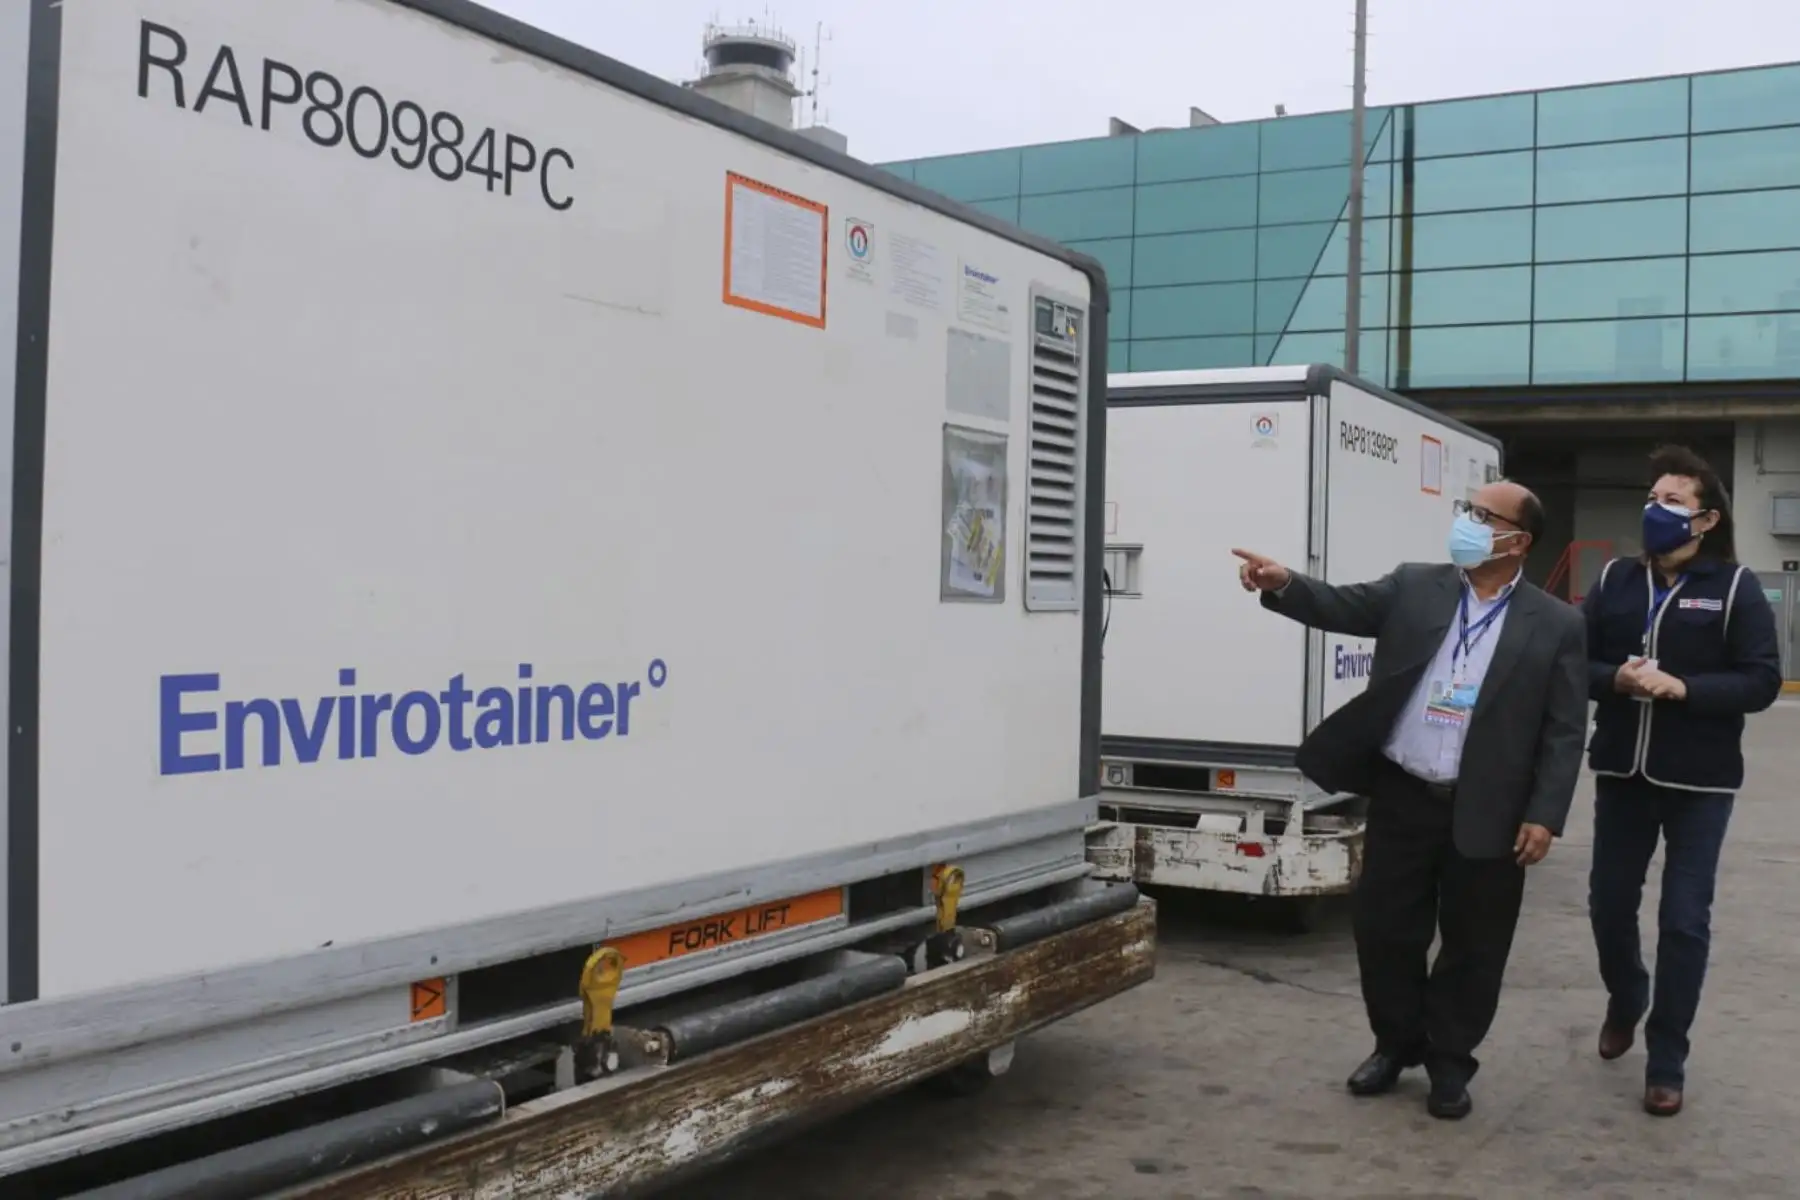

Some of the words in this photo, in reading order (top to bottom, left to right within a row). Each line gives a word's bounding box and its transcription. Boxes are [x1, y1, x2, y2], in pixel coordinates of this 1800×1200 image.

[137, 19, 575, 211] RAP80984PC
[1340, 420, 1399, 464] RAP81398PC
[668, 917, 736, 955] FORK
[745, 903, 791, 936] LIFT
